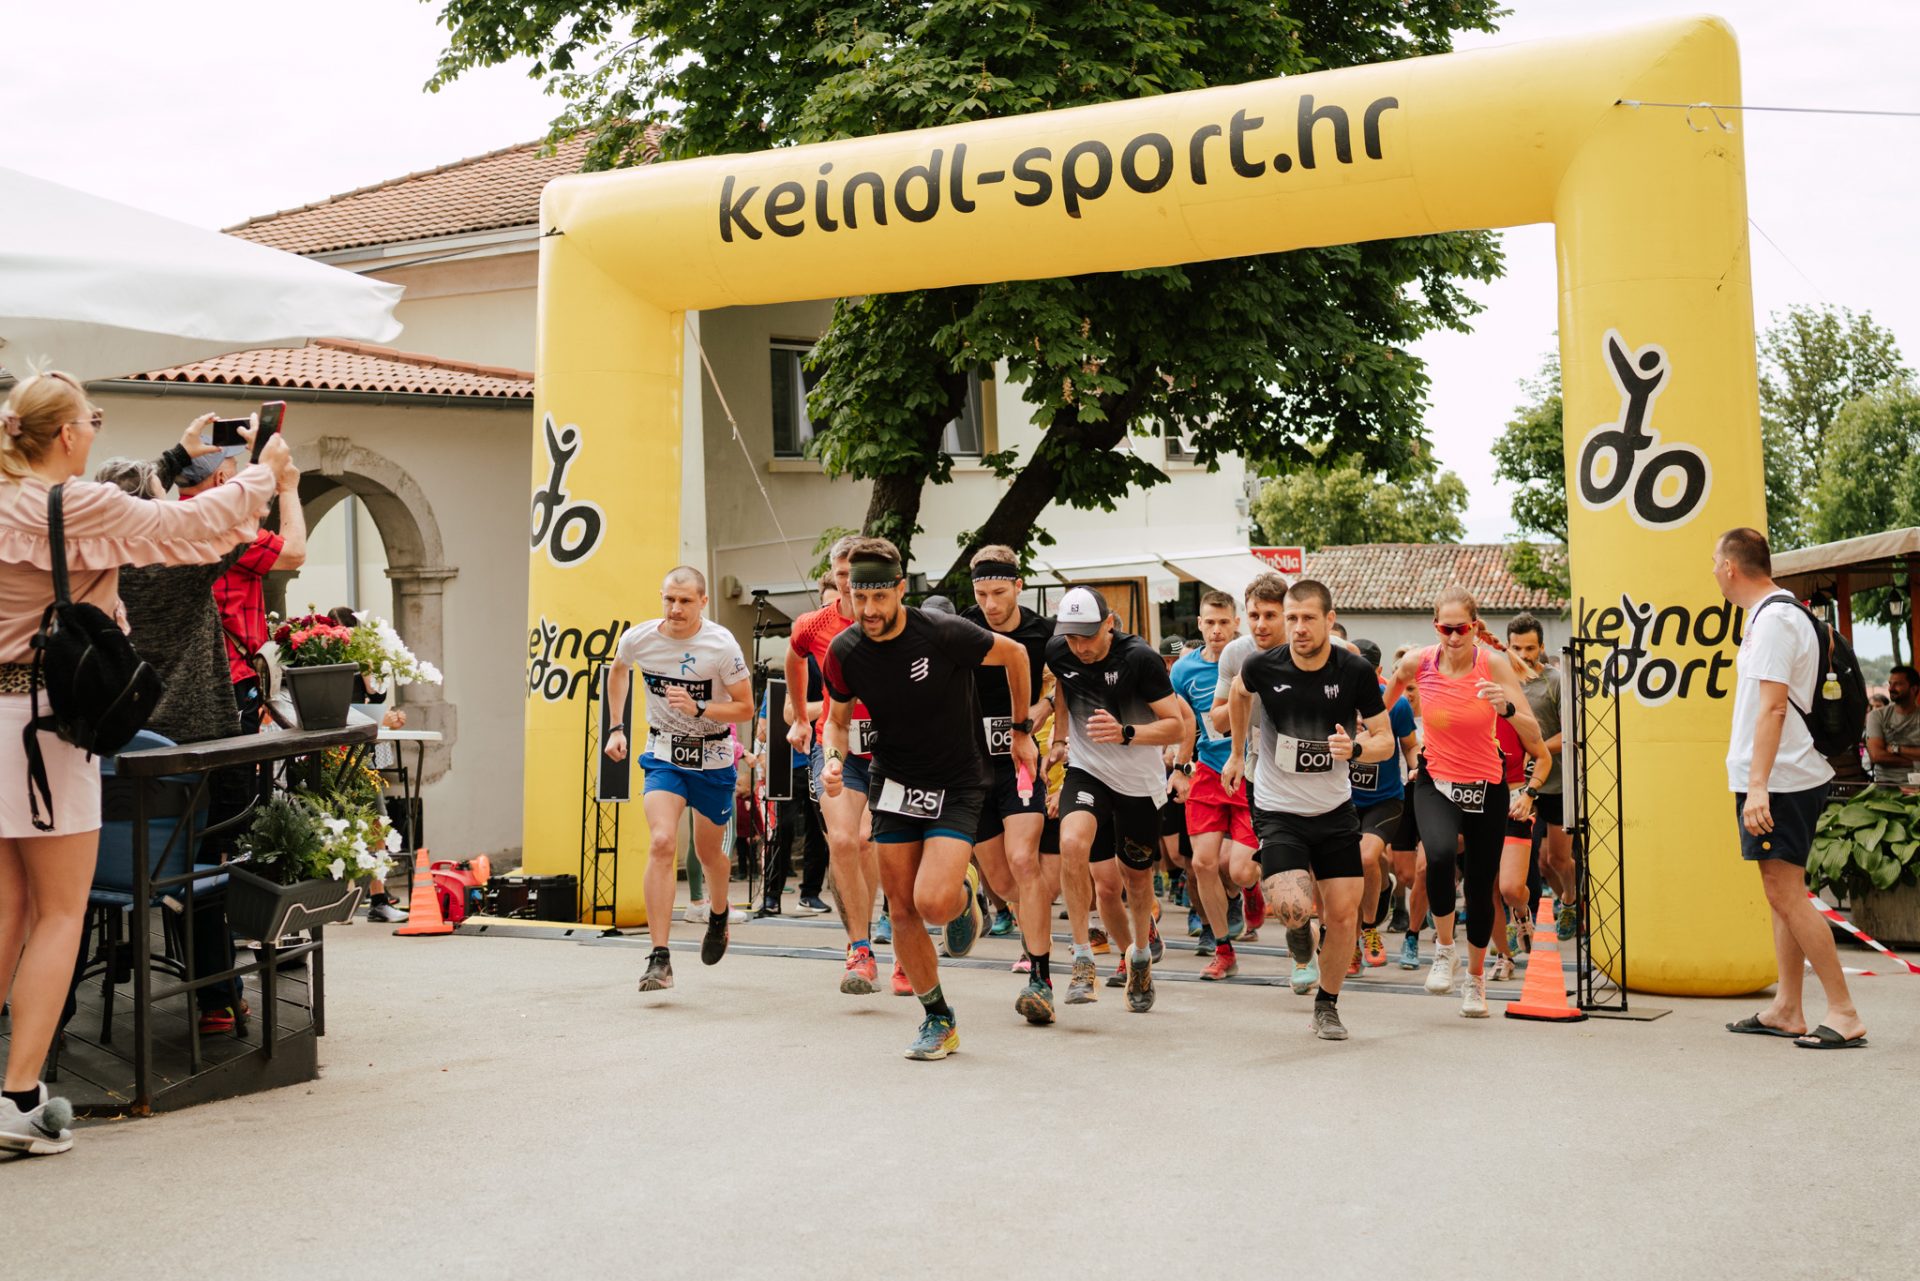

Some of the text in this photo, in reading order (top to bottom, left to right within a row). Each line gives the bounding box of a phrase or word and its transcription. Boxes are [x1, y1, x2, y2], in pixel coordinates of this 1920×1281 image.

[718, 94, 1399, 242] keindl-sport.hr
[1585, 650, 1733, 699] sport
[992, 731, 1013, 747] 06
[674, 747, 700, 762] 014
[1300, 753, 1330, 767] 001
[1352, 772, 1374, 784] 017
[907, 788, 938, 810] 125
[1452, 788, 1483, 804] 086
